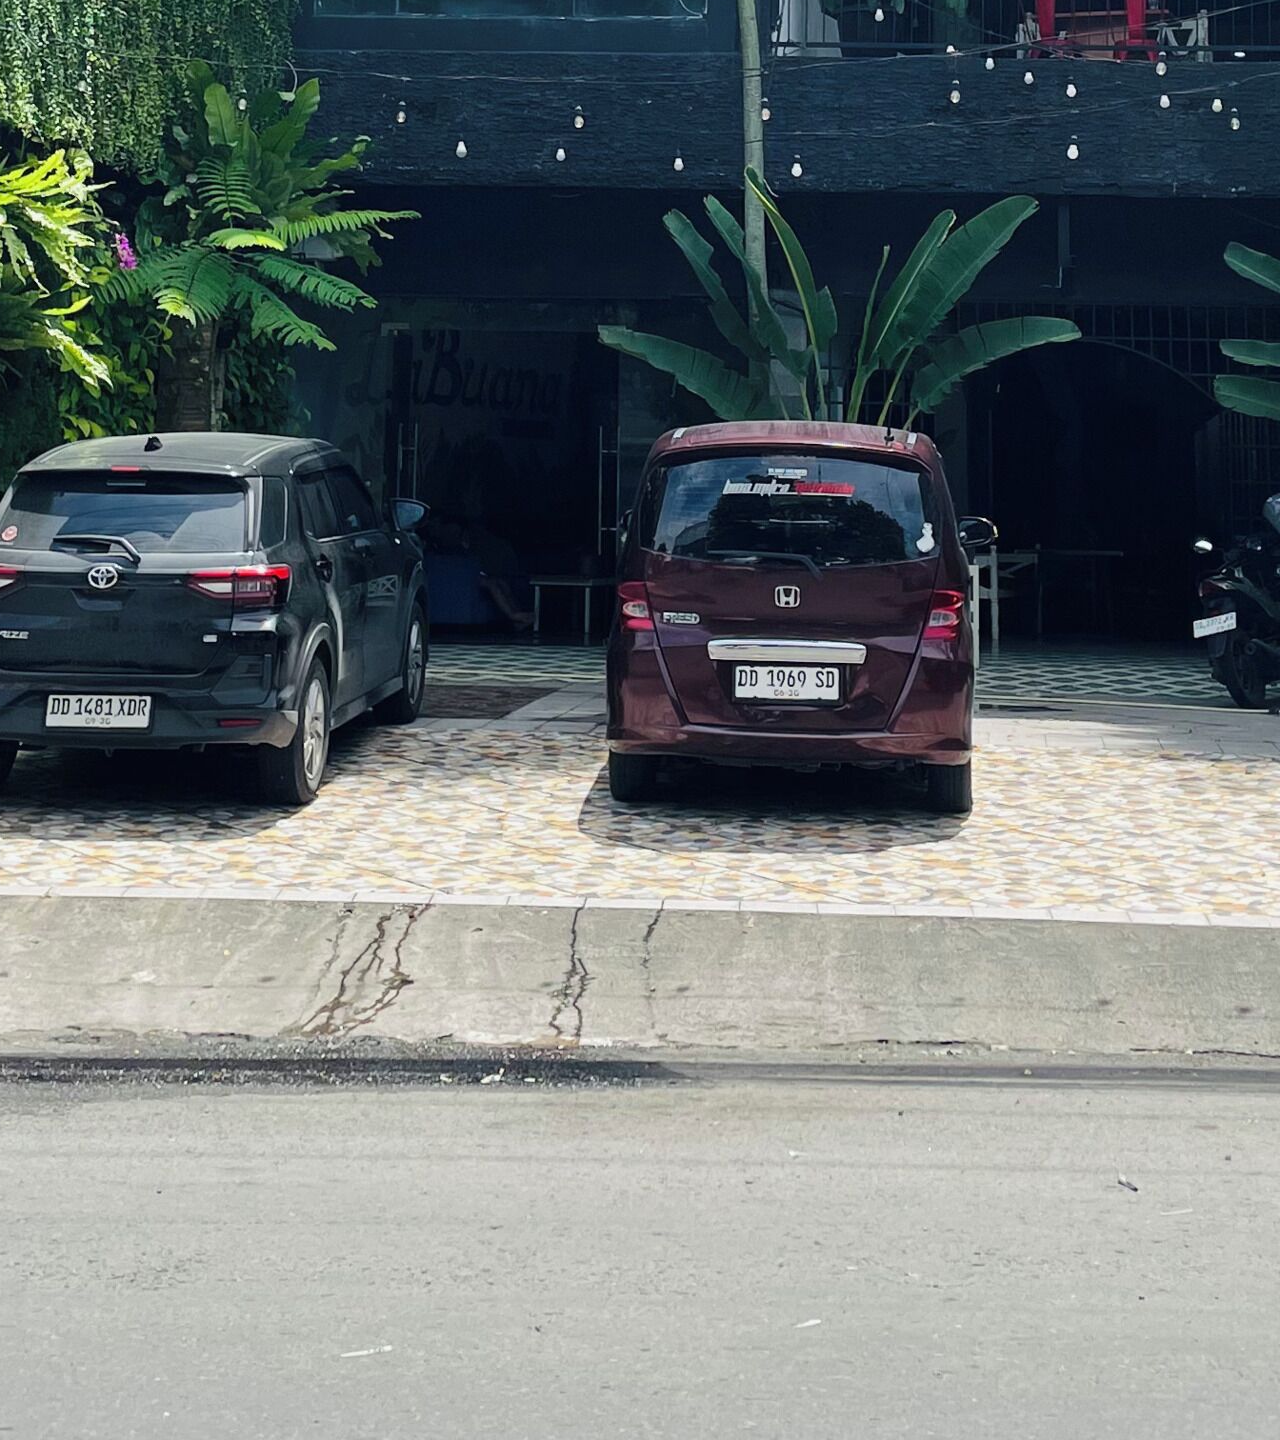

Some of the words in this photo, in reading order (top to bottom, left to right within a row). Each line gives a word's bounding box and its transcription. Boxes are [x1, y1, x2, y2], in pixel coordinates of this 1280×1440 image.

[738, 670, 758, 687] DD
[767, 670, 807, 688] 1969
[815, 671, 835, 688] SD
[50, 698, 71, 716] DD
[74, 698, 113, 716] 1481
[118, 698, 148, 716] XDR
